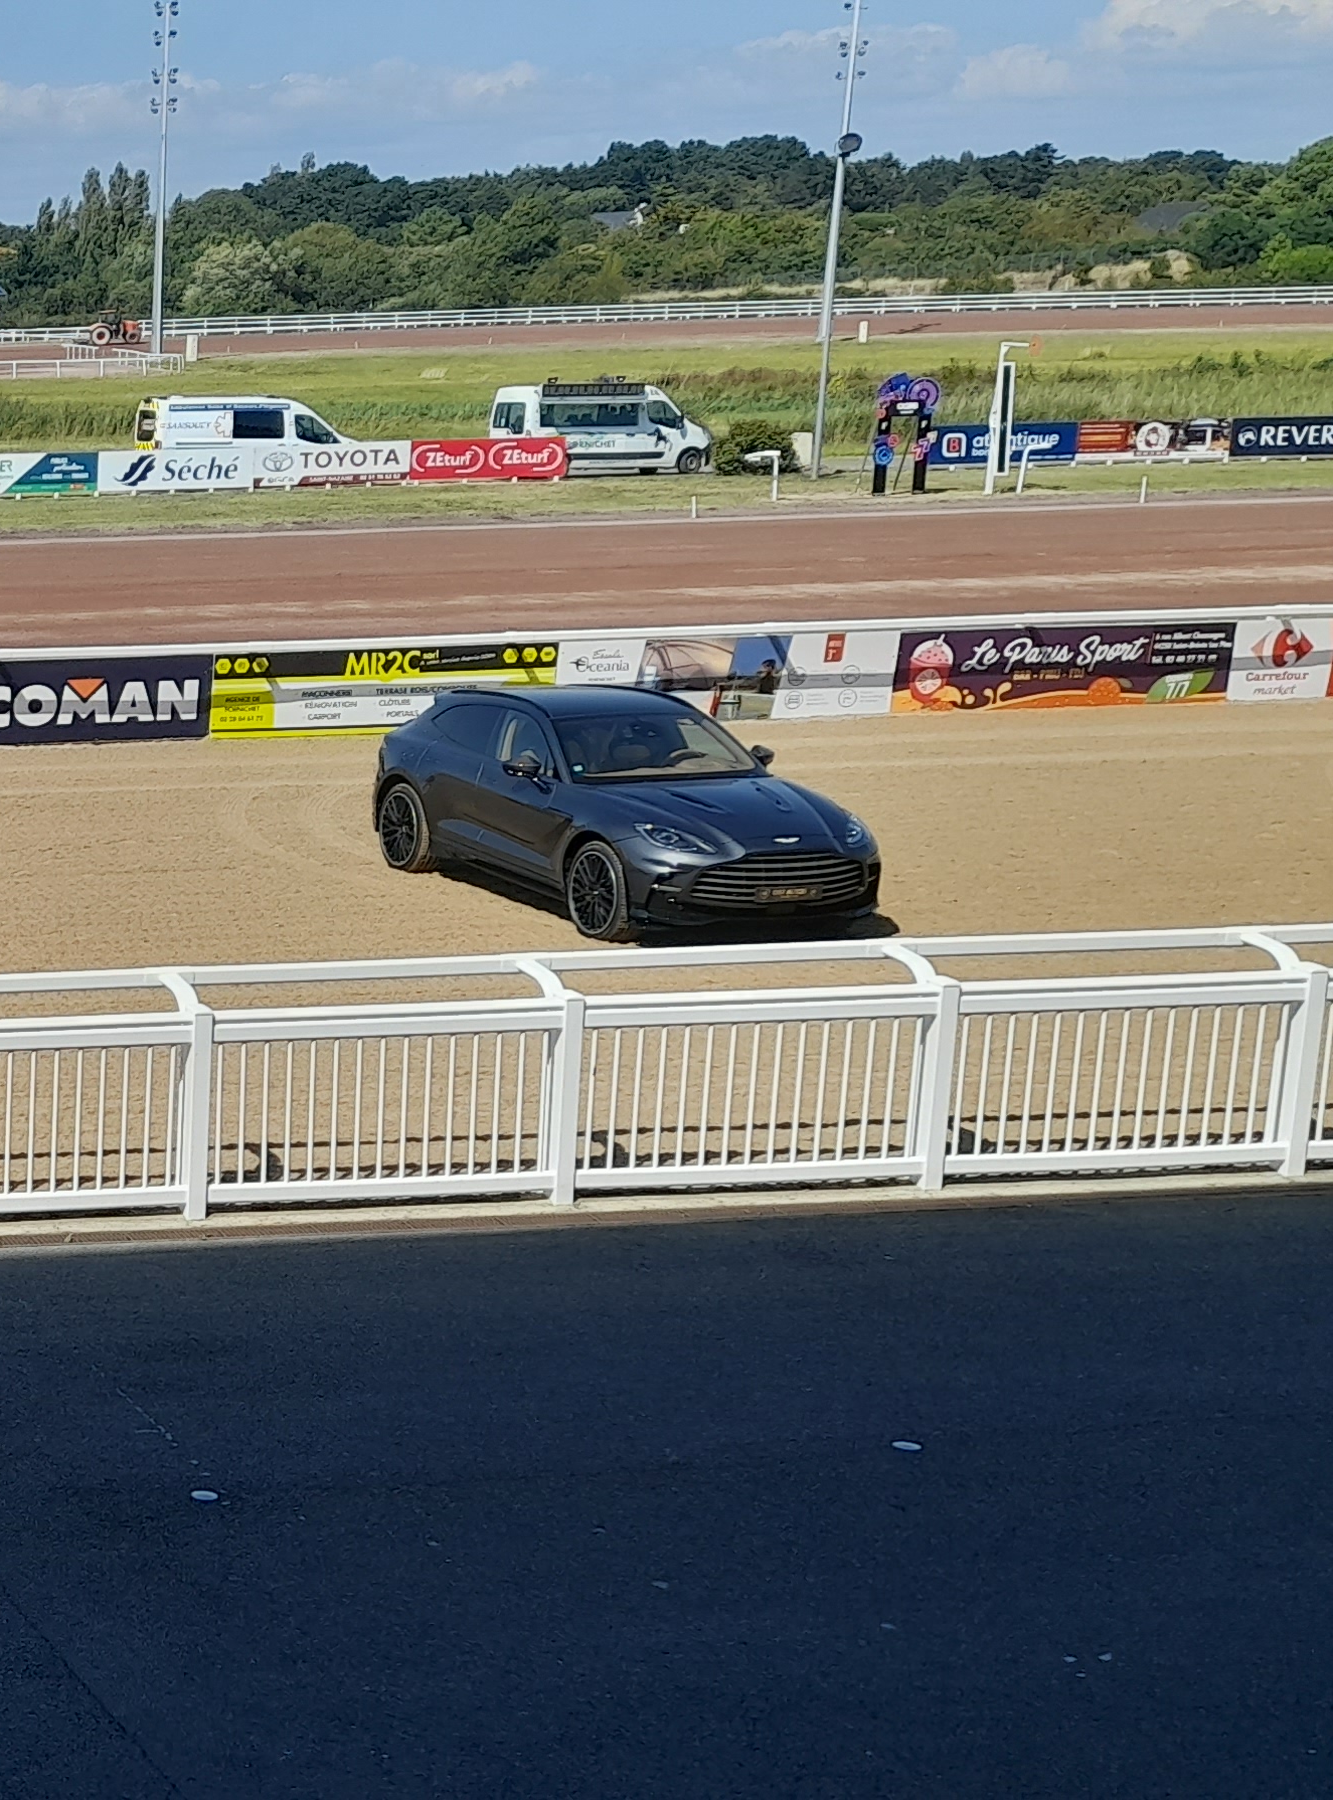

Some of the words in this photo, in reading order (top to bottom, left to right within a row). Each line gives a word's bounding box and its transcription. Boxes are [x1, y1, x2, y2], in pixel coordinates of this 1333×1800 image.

[299, 448, 400, 469] TOYOTA
[424, 450, 474, 467] ZEturf
[502, 448, 550, 465] ZEturf
[162, 456, 238, 482] Séché
[960, 638, 1001, 673] Le
[1003, 636, 1074, 674] Paris
[1076, 634, 1150, 673] Sport
[345, 650, 421, 676] MR2C
[575, 656, 630, 673] Oceania
[1245, 671, 1310, 682] Carrefour
[1253, 684, 1297, 695] market
